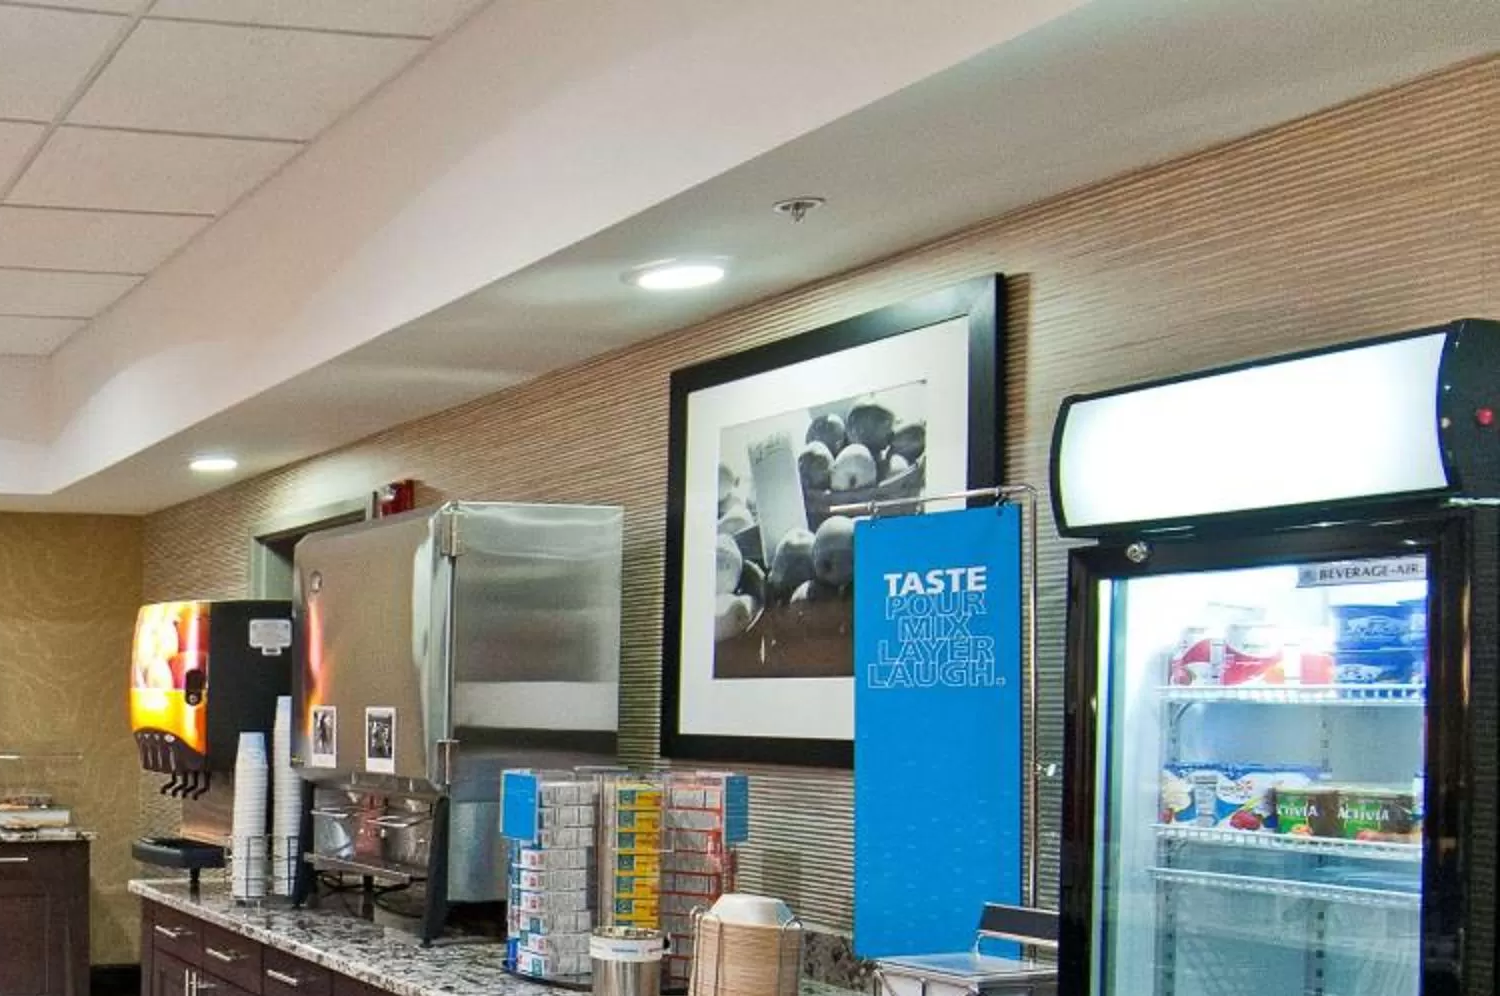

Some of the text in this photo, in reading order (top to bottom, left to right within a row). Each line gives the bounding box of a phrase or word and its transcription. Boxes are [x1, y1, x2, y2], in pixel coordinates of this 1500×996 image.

[883, 565, 987, 597] TASTE
[885, 590, 988, 620] POUR
[898, 615, 971, 642] MIX
[878, 636, 994, 665] LAYER
[867, 660, 1006, 688] LAUGH.
